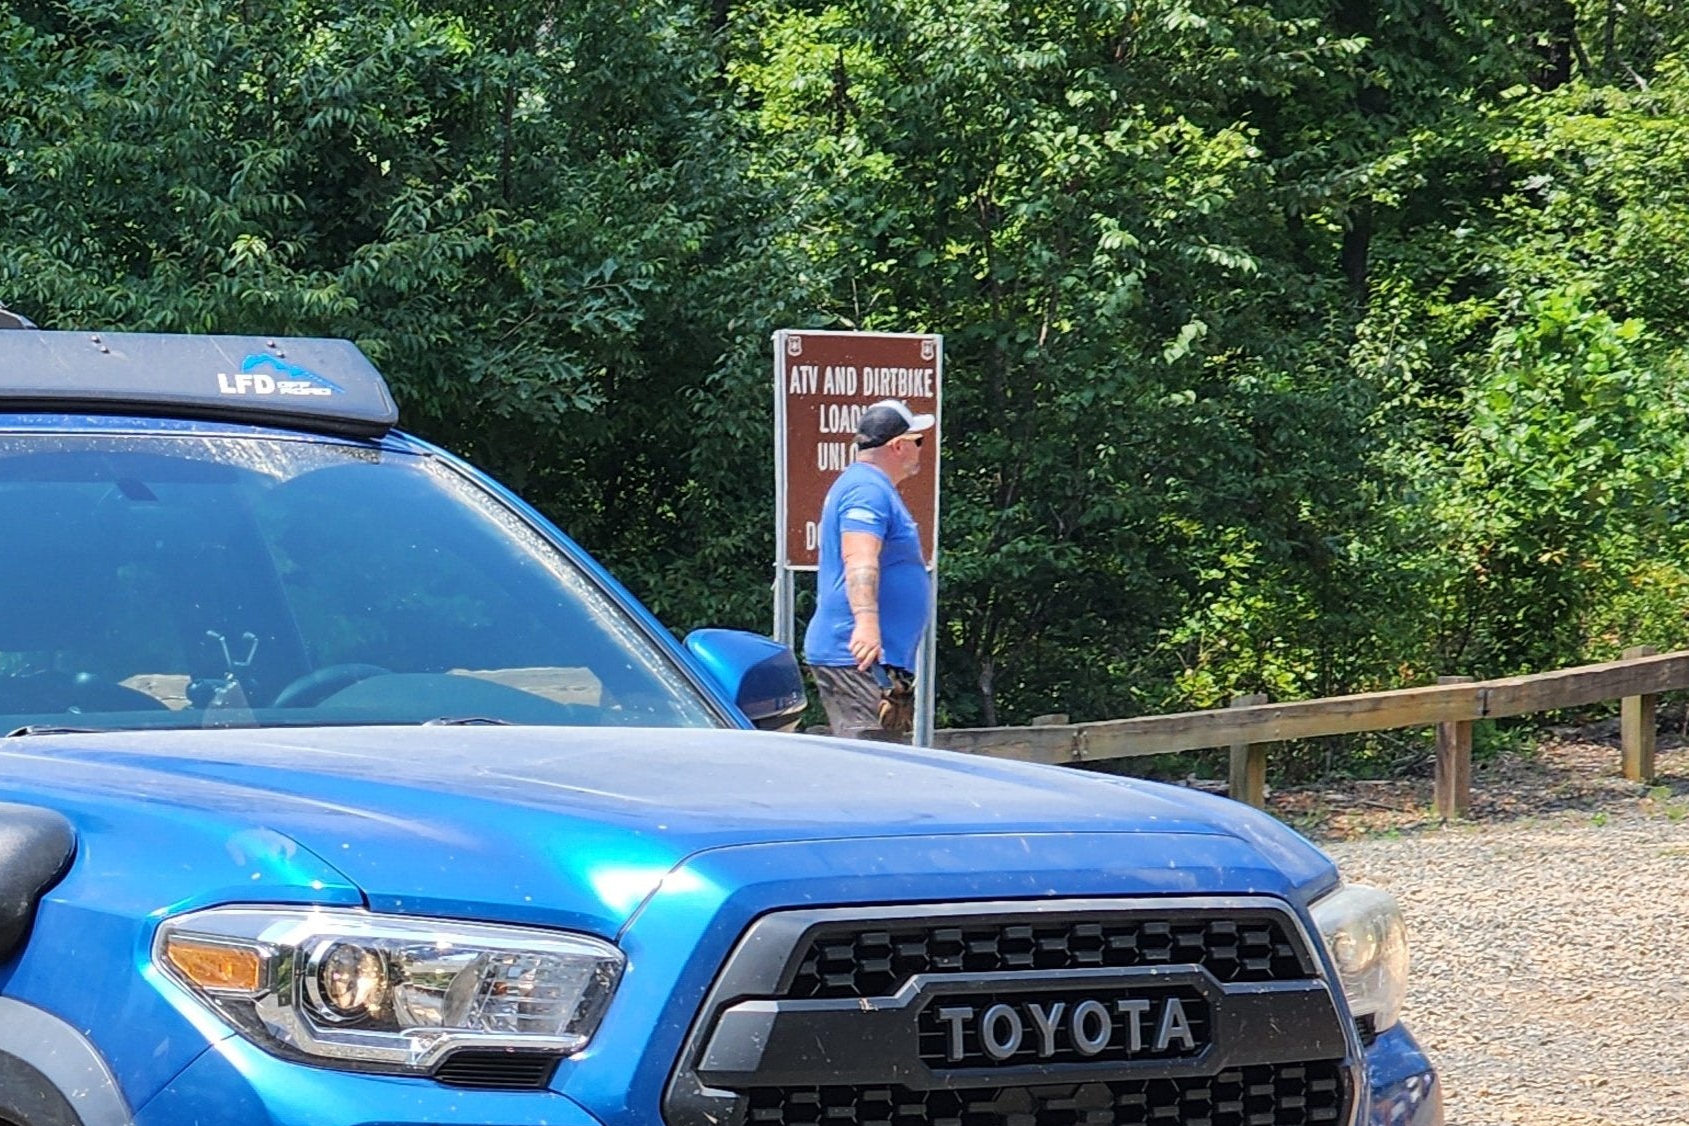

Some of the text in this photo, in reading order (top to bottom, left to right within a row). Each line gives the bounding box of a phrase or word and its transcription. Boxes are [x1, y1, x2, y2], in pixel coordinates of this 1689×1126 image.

[217, 373, 276, 396] LFD
[789, 365, 934, 398] ATV AND DIRTBIKE
[819, 404, 867, 433] LOAD
[935, 997, 1196, 1061] TOYOTA
